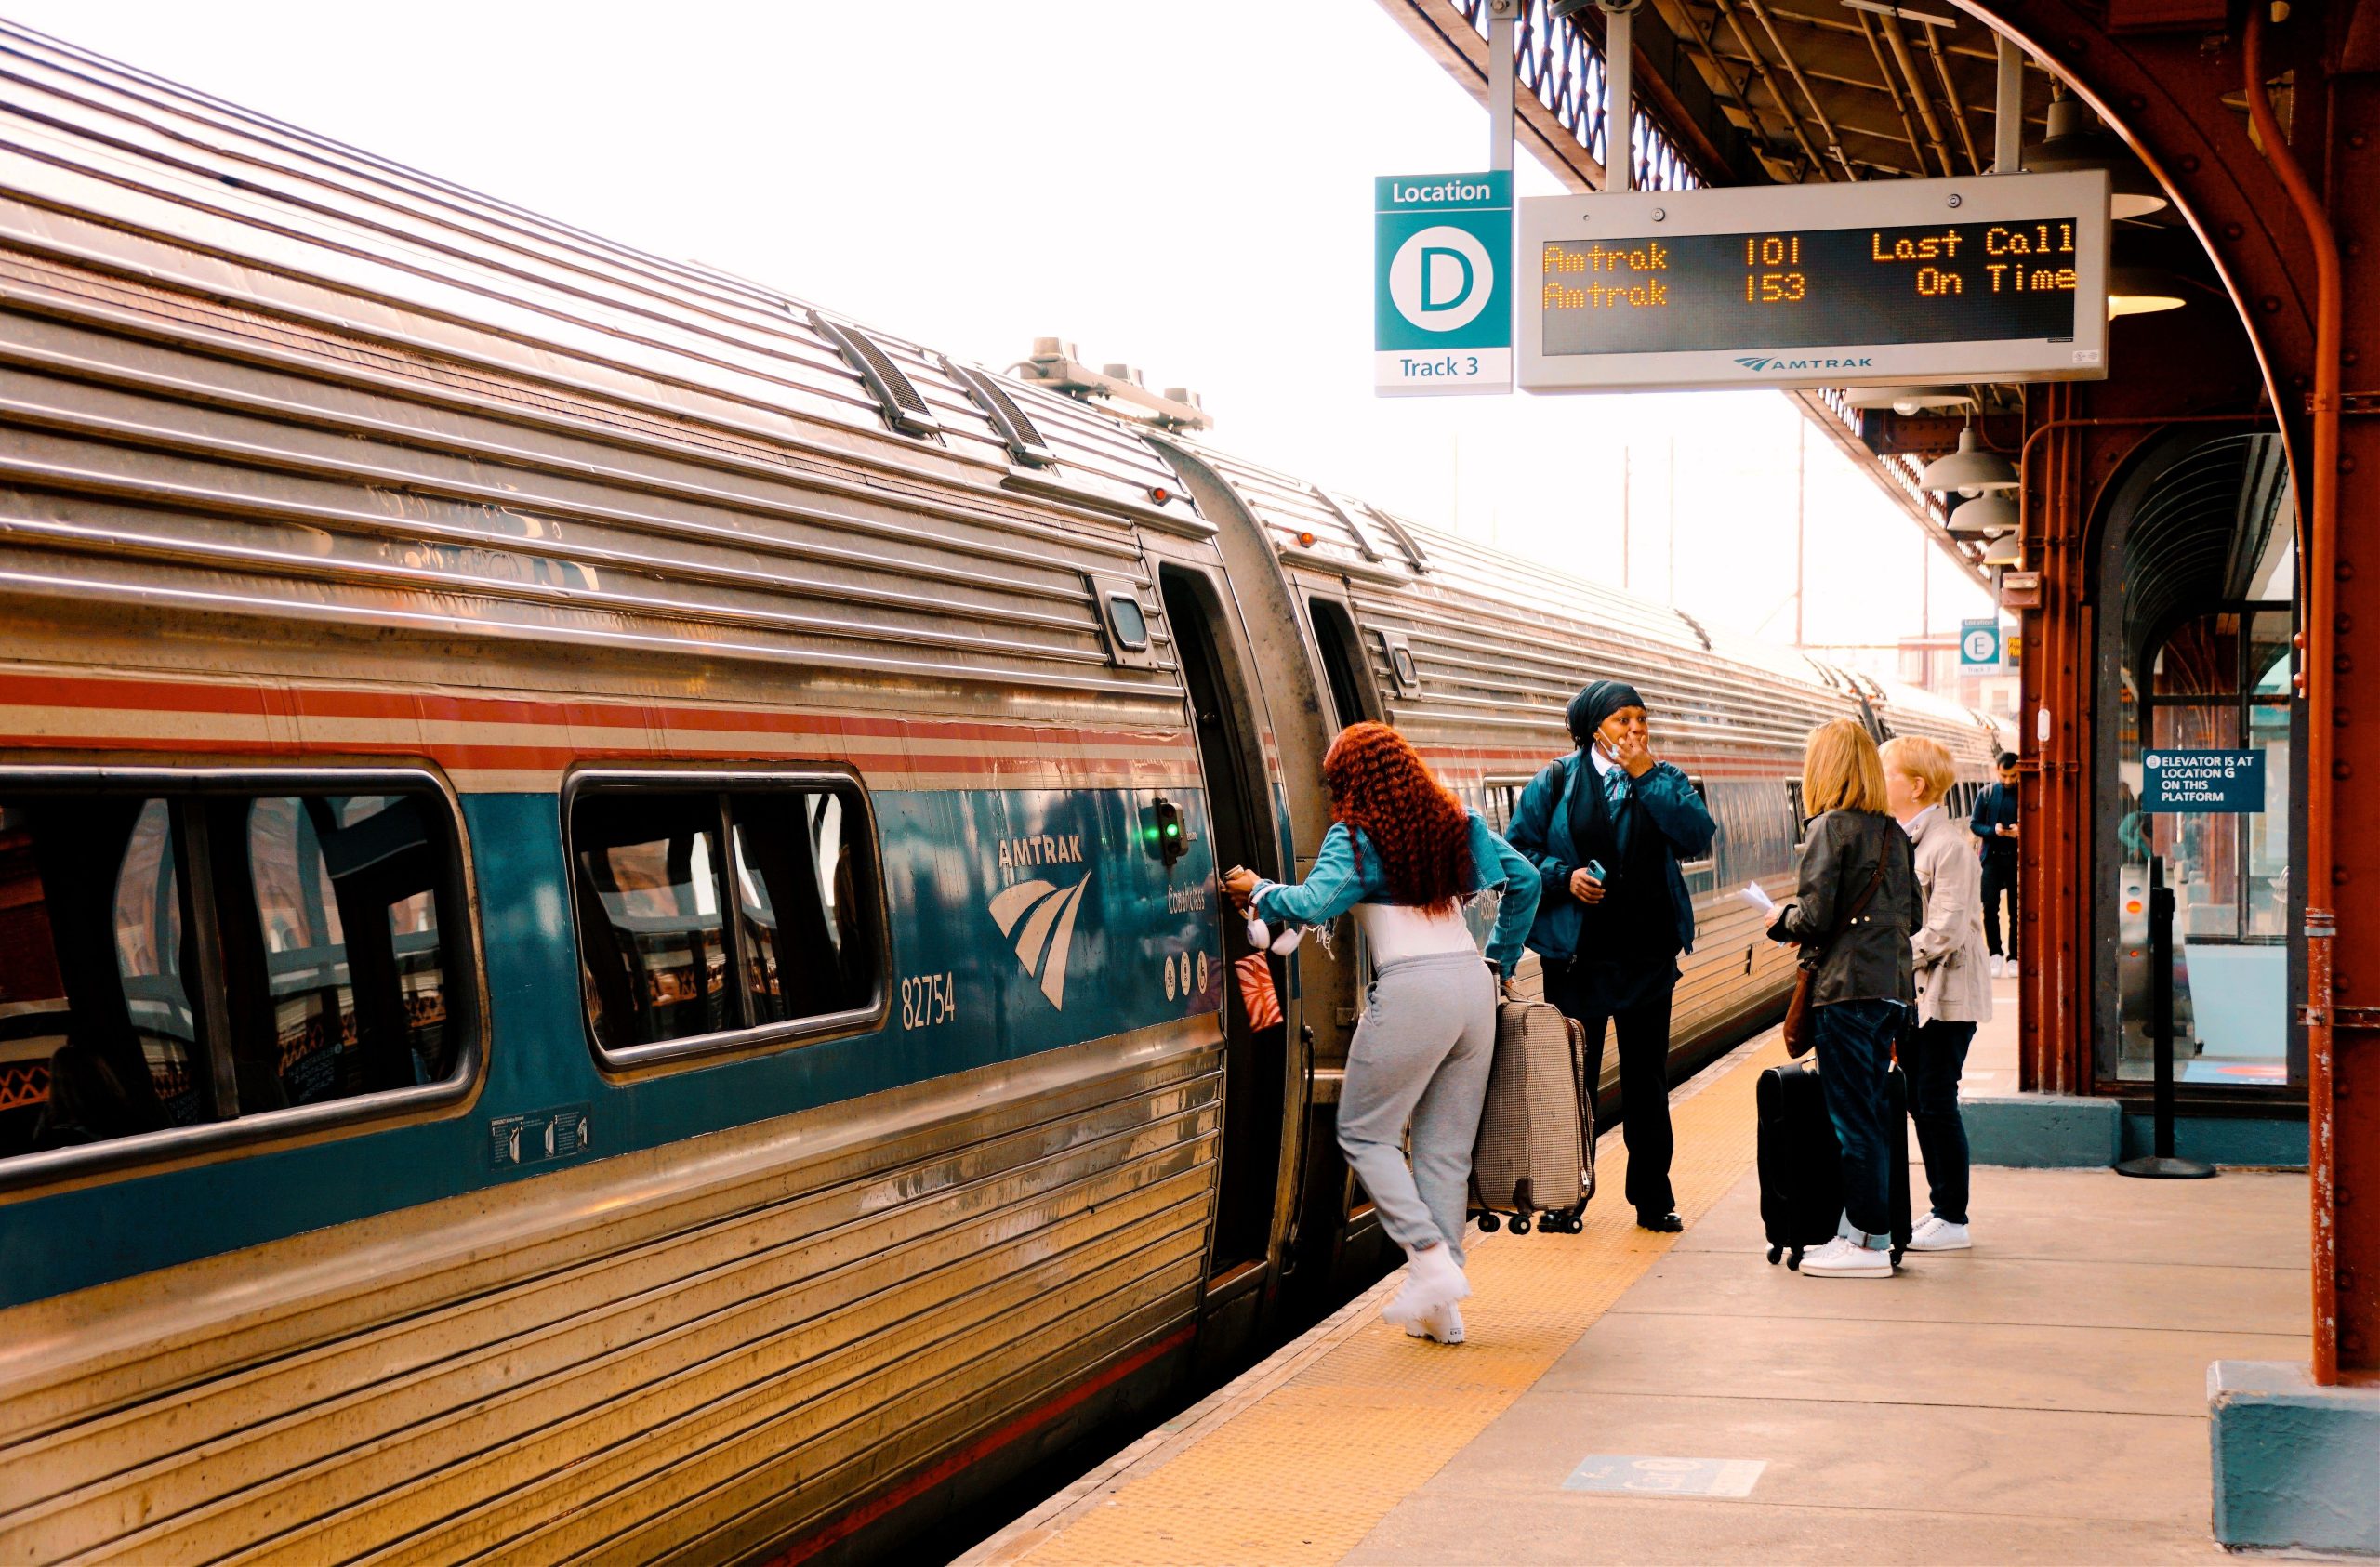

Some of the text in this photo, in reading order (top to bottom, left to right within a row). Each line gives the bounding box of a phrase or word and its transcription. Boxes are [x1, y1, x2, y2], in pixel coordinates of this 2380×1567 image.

[1393, 180, 1491, 203] Location
[1543, 223, 2075, 273] Amtrak 101 Last Call
[1421, 246, 1474, 312] D
[1543, 263, 2078, 309] Amtrak 153 On Time
[1400, 356, 1479, 377] Track 3
[1770, 357, 1872, 370] AMTRAK
[1974, 637, 1986, 655] E
[2162, 756, 2254, 767] ELEVATOR IS AT
[2162, 768, 2236, 779] LOCATION G
[2162, 780, 2209, 790] ON THIS
[2162, 792, 2225, 802] PLATFORM
[998, 834, 1084, 868] AMTRAK
[901, 970, 956, 1031] 82754
